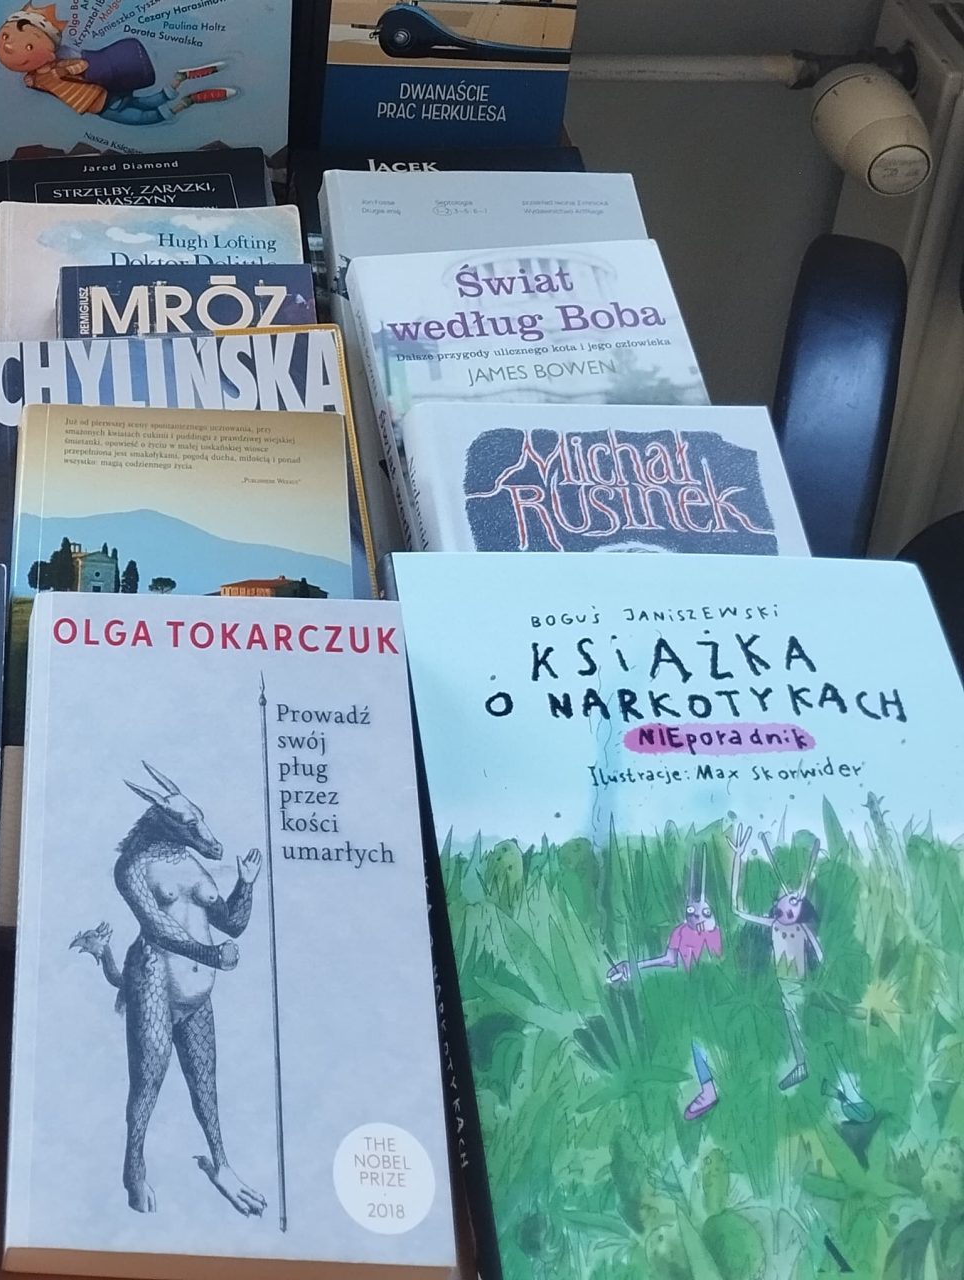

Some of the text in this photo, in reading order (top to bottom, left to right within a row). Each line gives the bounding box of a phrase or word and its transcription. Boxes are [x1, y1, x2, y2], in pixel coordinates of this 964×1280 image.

[69, 13, 80, 36] Olga
[91, 11, 136, 38] Agnieszka
[138, 11, 170, 24] Cezary
[163, 21, 226, 31] Paulina Holtz
[123, 25, 203, 47] Dorota Suwalska
[400, 80, 489, 101] DWANAŚCIE
[377, 103, 506, 122] PRAC HERKULESA
[84, 161, 178, 172] Jared Diamond
[367, 159, 440, 172] JACEK
[53, 182, 215, 198] STRZELBY, ZARAZKI,
[96, 194, 177, 205] MASZYNY
[159, 233, 276, 252] Hugh Lofting
[455, 264, 574, 299] Świat
[79, 287, 90, 335] REMIGIUSZ
[387, 302, 666, 343] według Boba
[397, 337, 671, 362] Dalsze przygody ulicznego kota jego człowieka
[468, 360, 616, 387] JAMES BOWEN
[53, 618, 399, 654] OLGA TOKARCZUK
[485, 682, 907, 723] O NARKOTYKACH
[277, 704, 370, 724] Prowadź
[278, 731, 326, 754] swój
[279, 757, 328, 783] pług
[588, 757, 862, 786] Ilustracje: Max Skorwider
[280, 789, 338, 810] przez
[281, 810, 339, 833] kości
[282, 841, 395, 869] umarłych
[364, 1137, 396, 1152] THE
[354, 1154, 411, 1170] NOBEL
[359, 1172, 407, 1187] PRIZE
[367, 1203, 405, 1219] 2018
